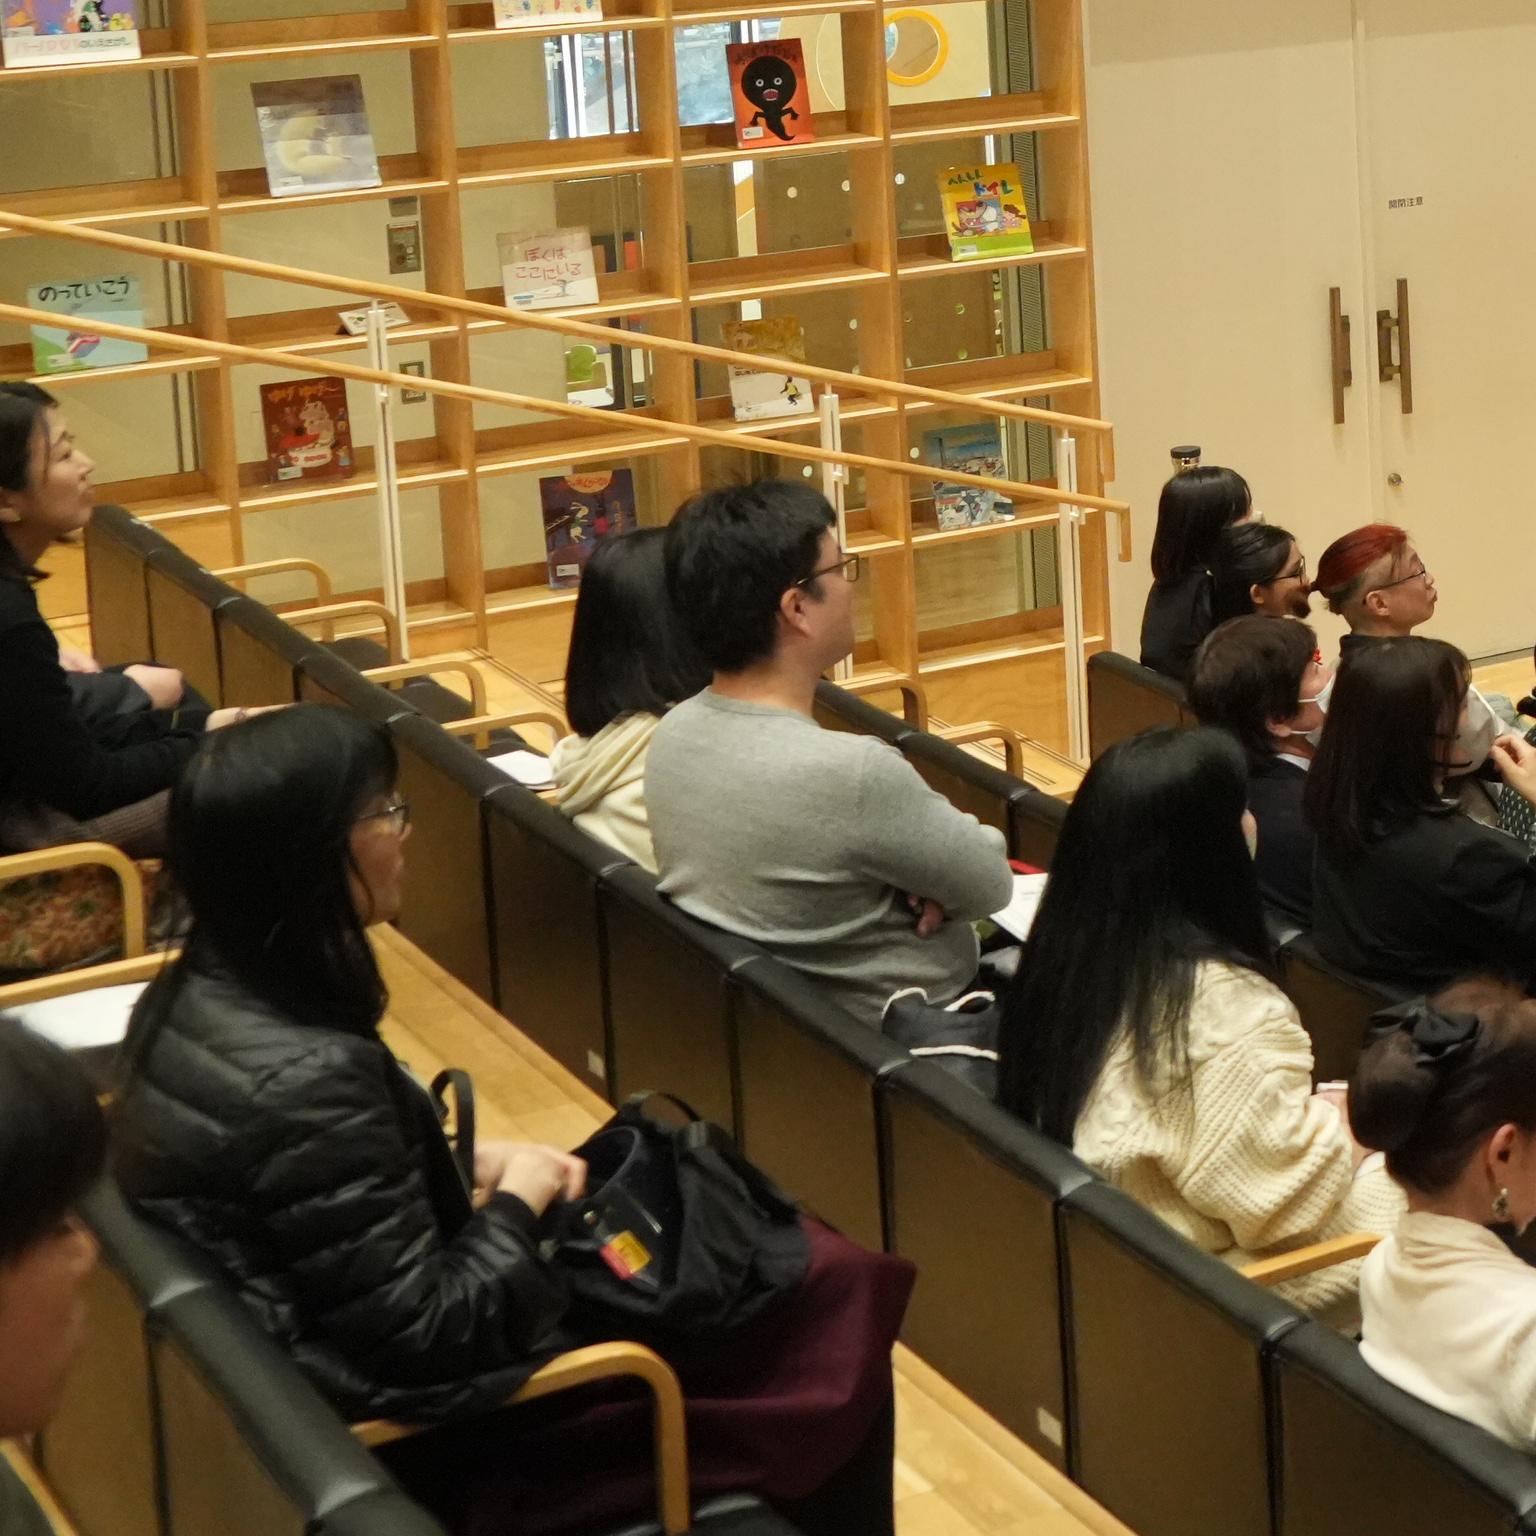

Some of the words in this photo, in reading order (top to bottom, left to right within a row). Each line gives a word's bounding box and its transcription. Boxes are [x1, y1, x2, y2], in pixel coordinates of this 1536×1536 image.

[525, 246, 566, 262] ぼくは
[515, 263, 583, 281] ここにいる
[41, 279, 131, 302] のっていこう
